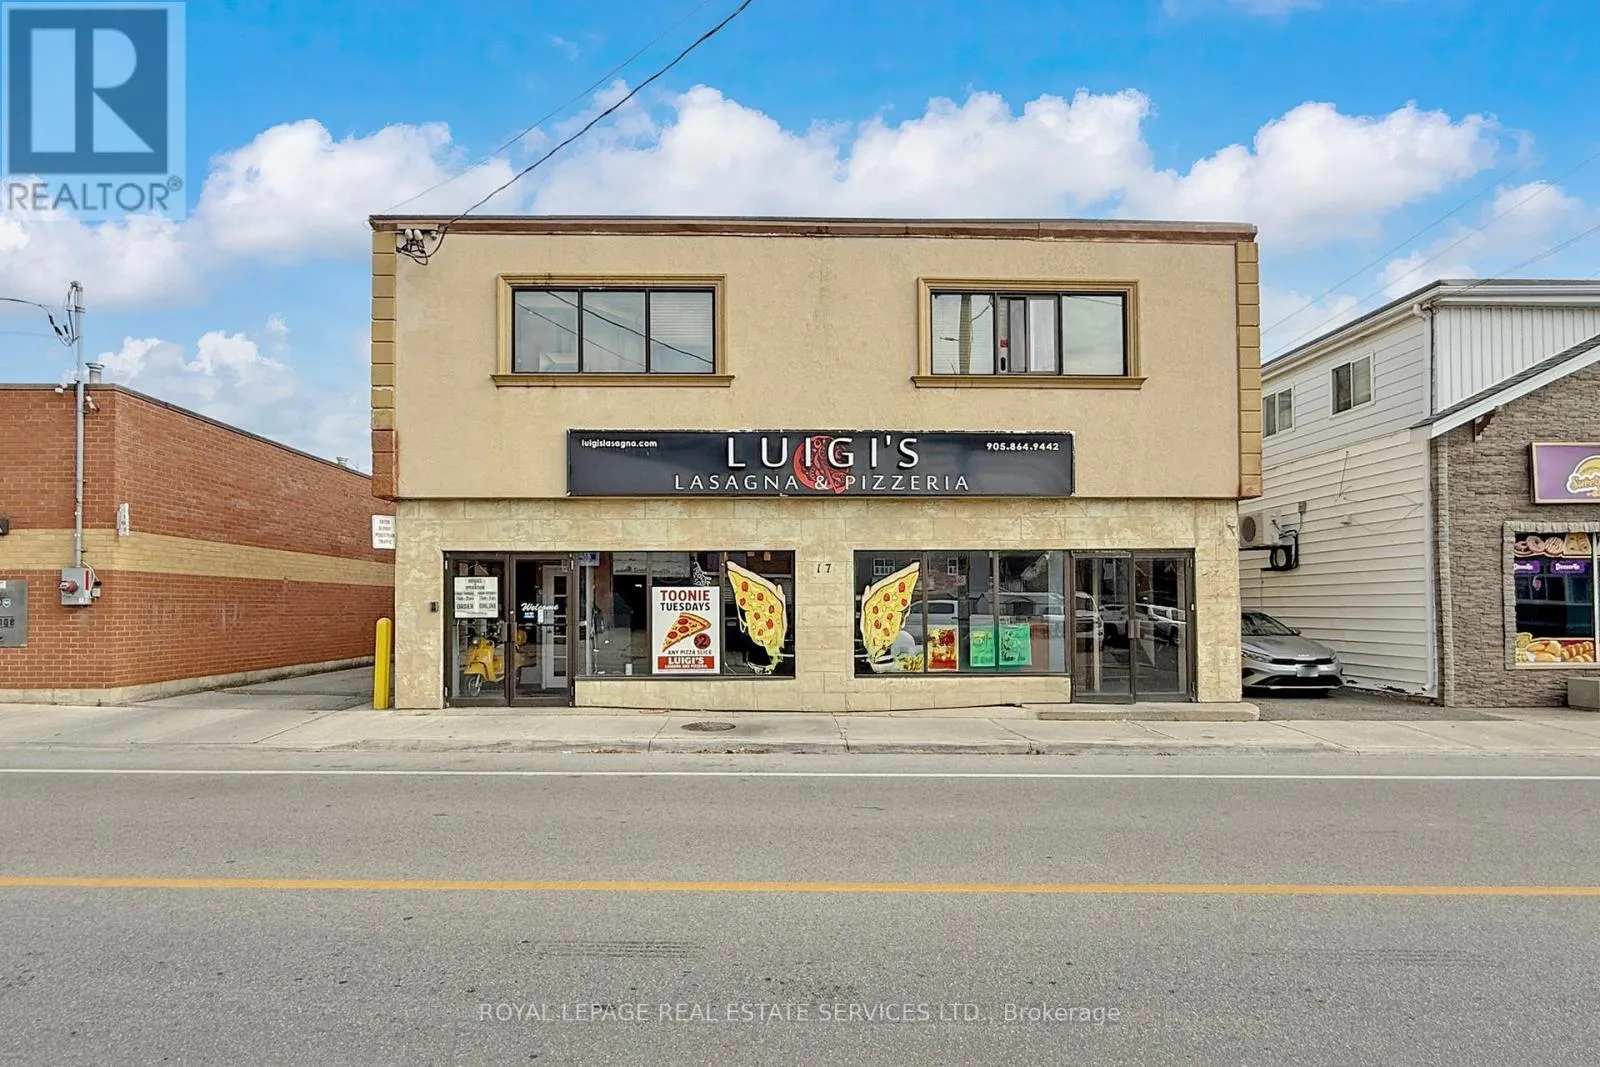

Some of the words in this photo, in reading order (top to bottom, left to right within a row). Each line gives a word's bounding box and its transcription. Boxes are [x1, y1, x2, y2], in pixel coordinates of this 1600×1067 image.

[581, 438, 658, 449] luigislasagna.com
[986, 442, 1060, 451] 905.864.9442
[727, 435, 920, 468] LUIGI'S
[674, 474, 800, 490] LASAGNA
[814, 475, 829, 490] &
[845, 475, 969, 491] PIZZERIA
[816, 563, 831, 574] 17
[660, 590, 710, 601] TOONIE
[520, 602, 560, 611] Welcome
[660, 602, 711, 612] TUESDAYS
[668, 656, 705, 665] LUIGI'S
